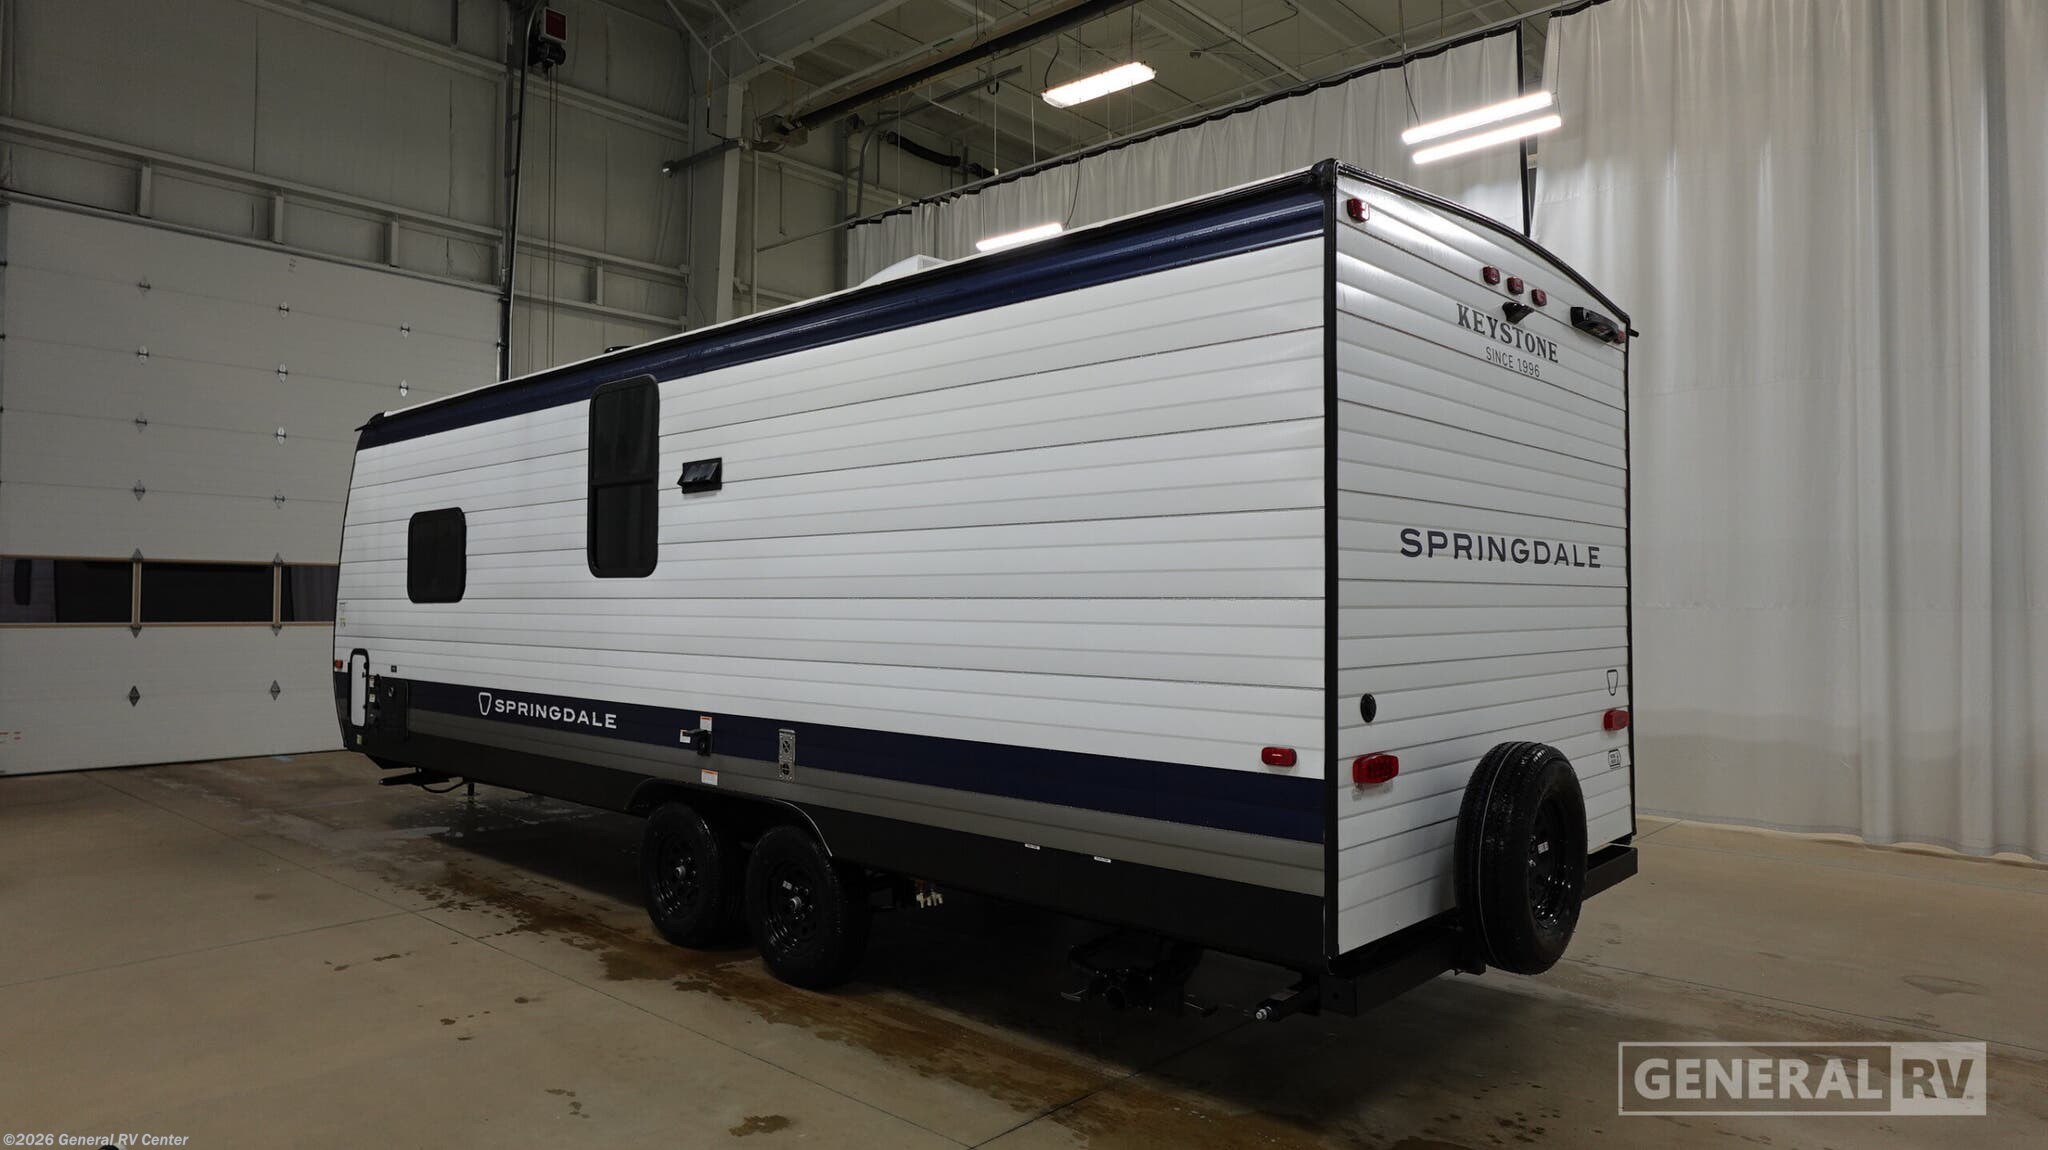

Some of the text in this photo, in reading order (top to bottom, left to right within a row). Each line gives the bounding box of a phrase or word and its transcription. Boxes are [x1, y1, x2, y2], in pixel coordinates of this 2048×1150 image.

[1456, 302, 1558, 363] KEYSTONE
[1486, 346, 1540, 378] SINCE 1996
[1400, 528, 1601, 569] SPRINGDALE
[495, 699, 617, 729] SPRINGDALE
